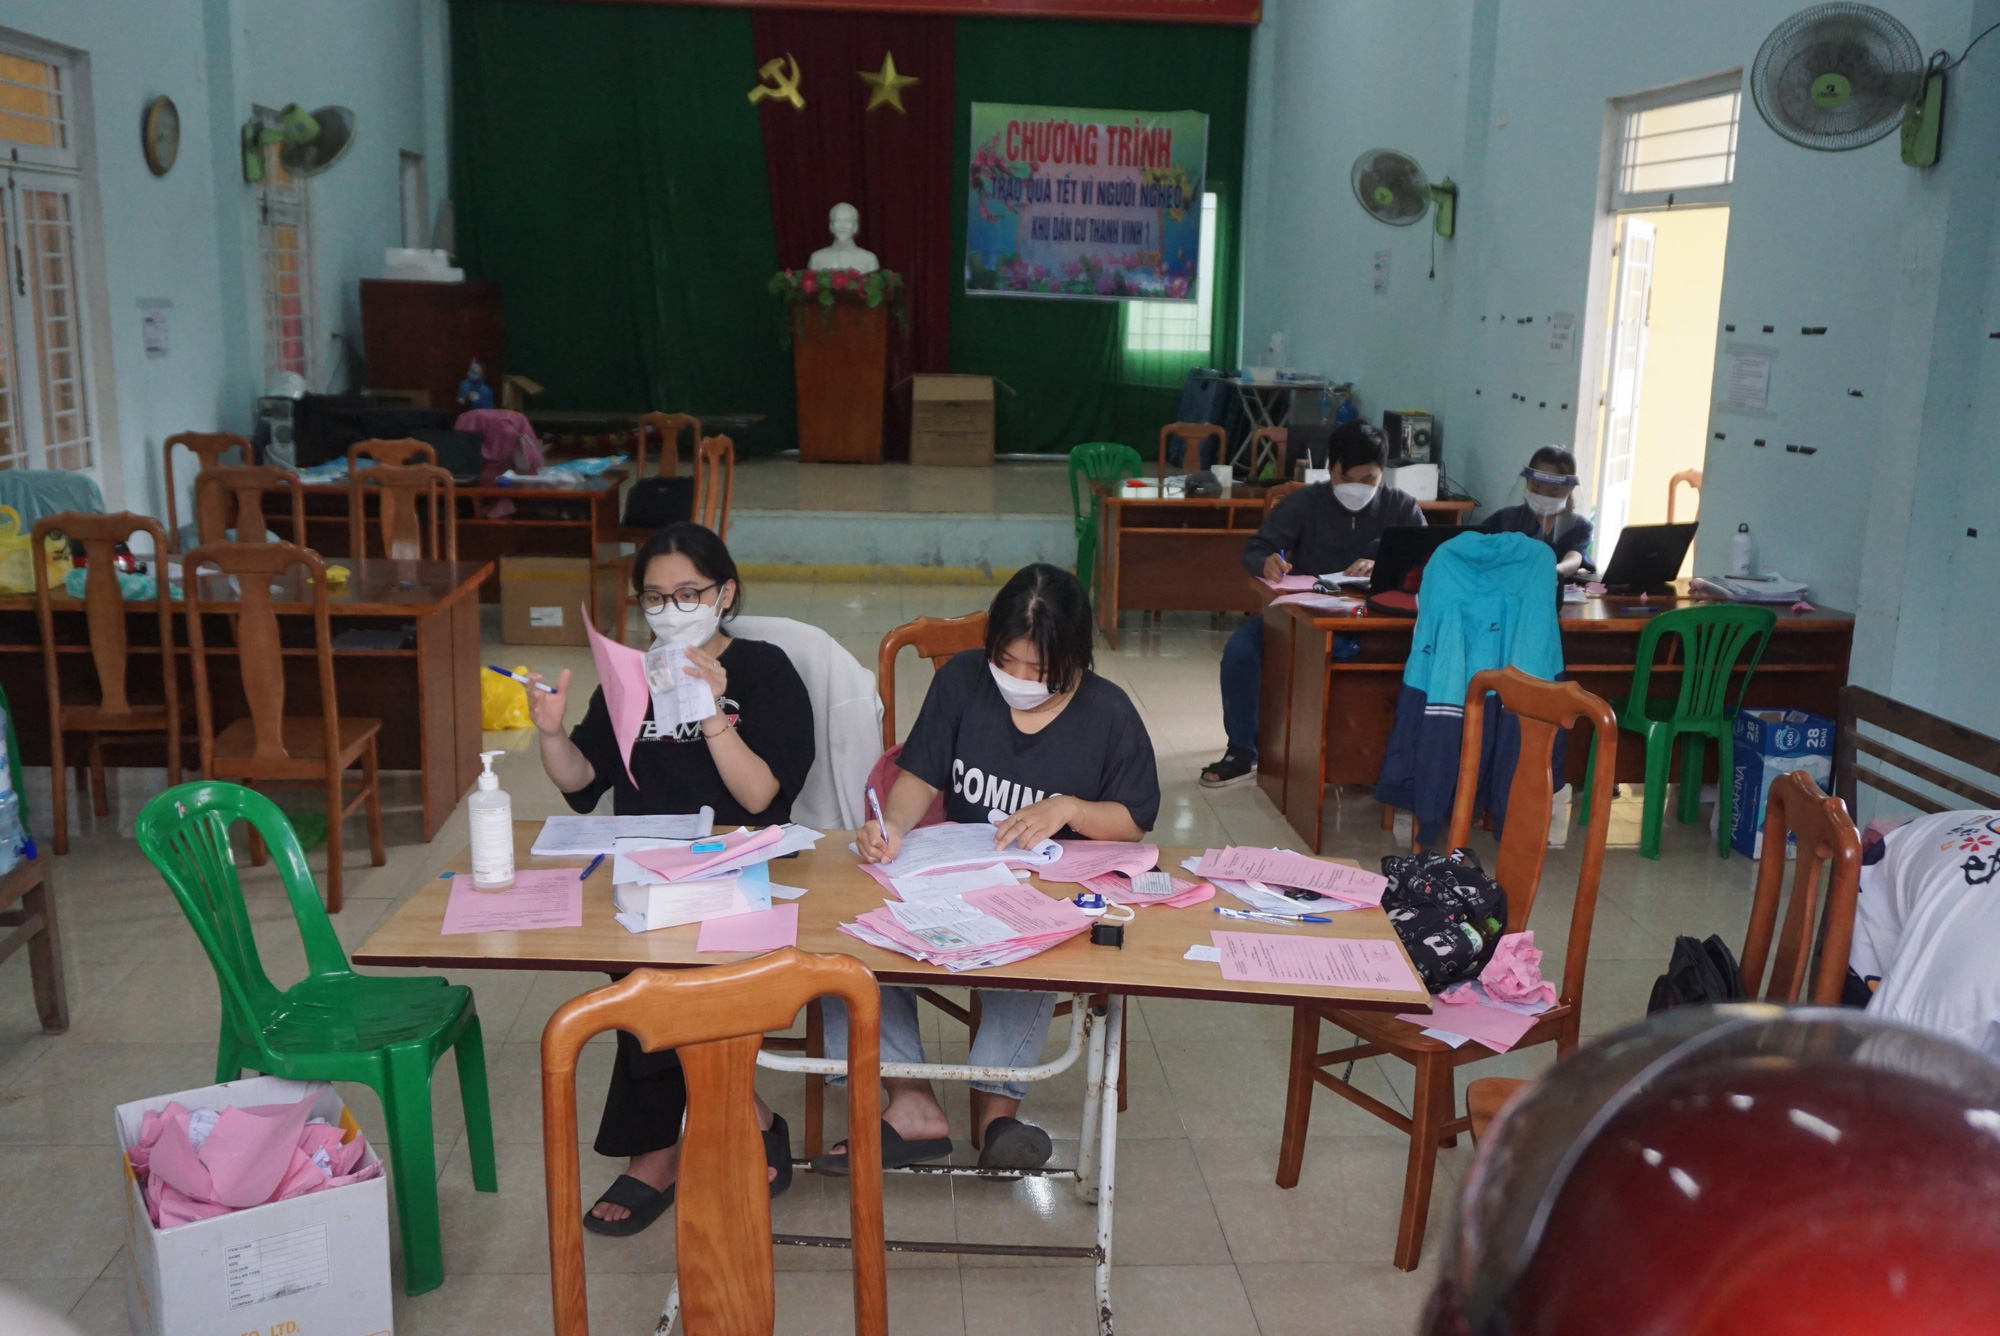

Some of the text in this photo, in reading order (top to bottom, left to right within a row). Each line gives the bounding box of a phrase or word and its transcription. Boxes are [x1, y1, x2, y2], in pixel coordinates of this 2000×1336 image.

[1006, 117, 1172, 169] CHƯƠNG TRÌNH
[992, 174, 1023, 202] TRAO
[1026, 172, 1052, 205] QUÀ
[1056, 171, 1078, 204] TẾT
[1081, 174, 1094, 205] VÌ
[1096, 175, 1136, 207] NGƯỜI
[1746, 721, 1755, 742] 28
[1806, 728, 1820, 749] 28
[1819, 728, 1828, 748] CHAI
[952, 758, 1063, 815] COMIN
